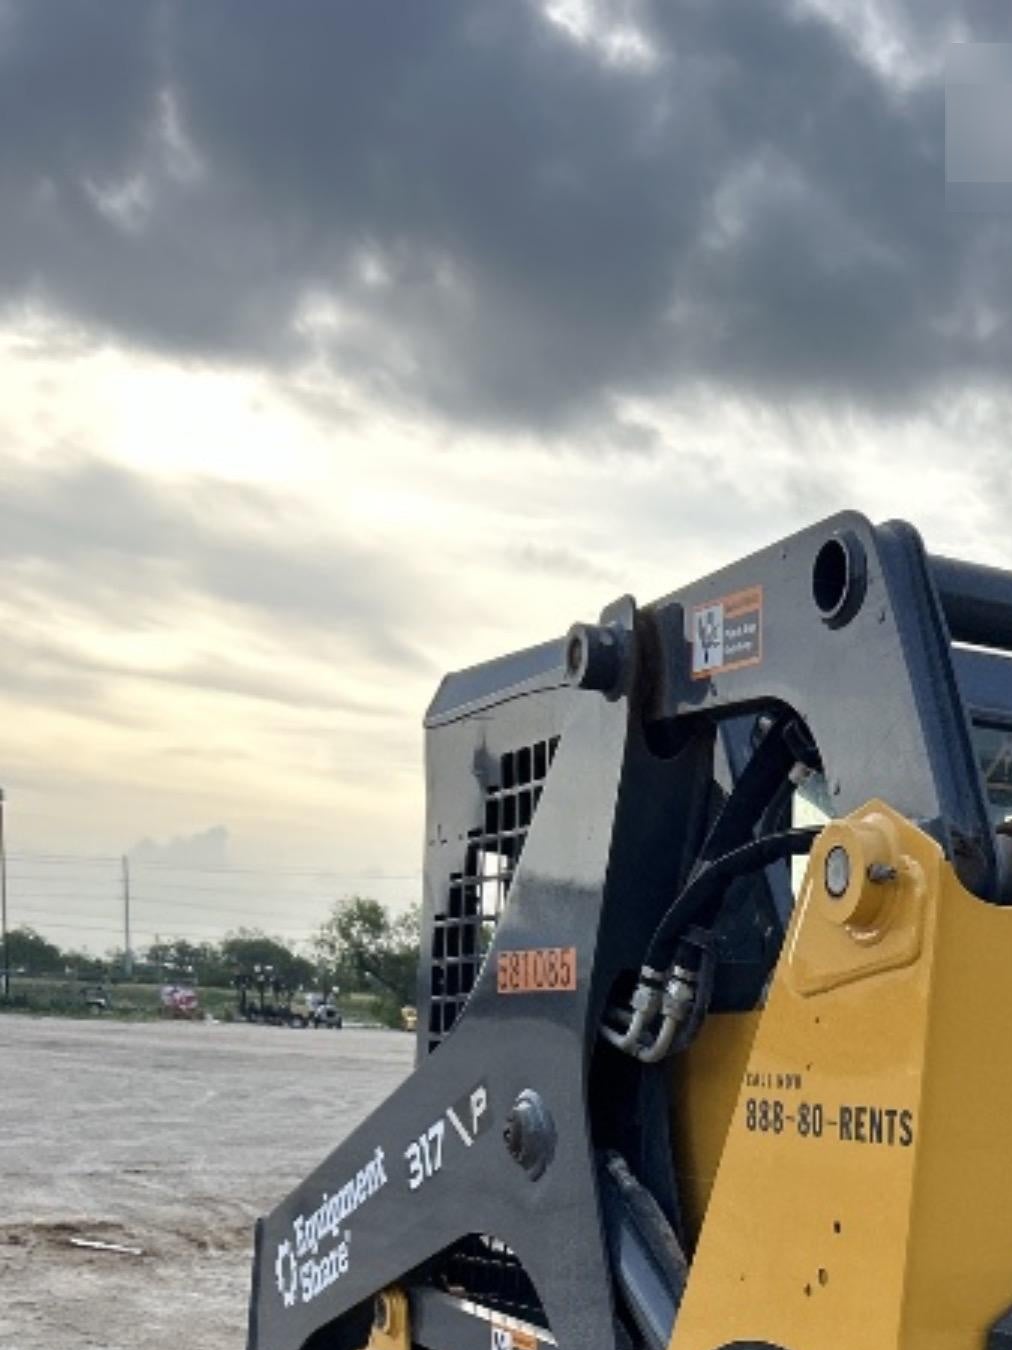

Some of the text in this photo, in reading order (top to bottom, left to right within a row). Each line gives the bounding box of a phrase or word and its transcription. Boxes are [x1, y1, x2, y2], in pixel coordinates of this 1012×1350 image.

[745, 1097, 913, 1147] 888-80-RENTS
[293, 1145, 388, 1256] Equipment
[301, 1241, 349, 1302] Share
